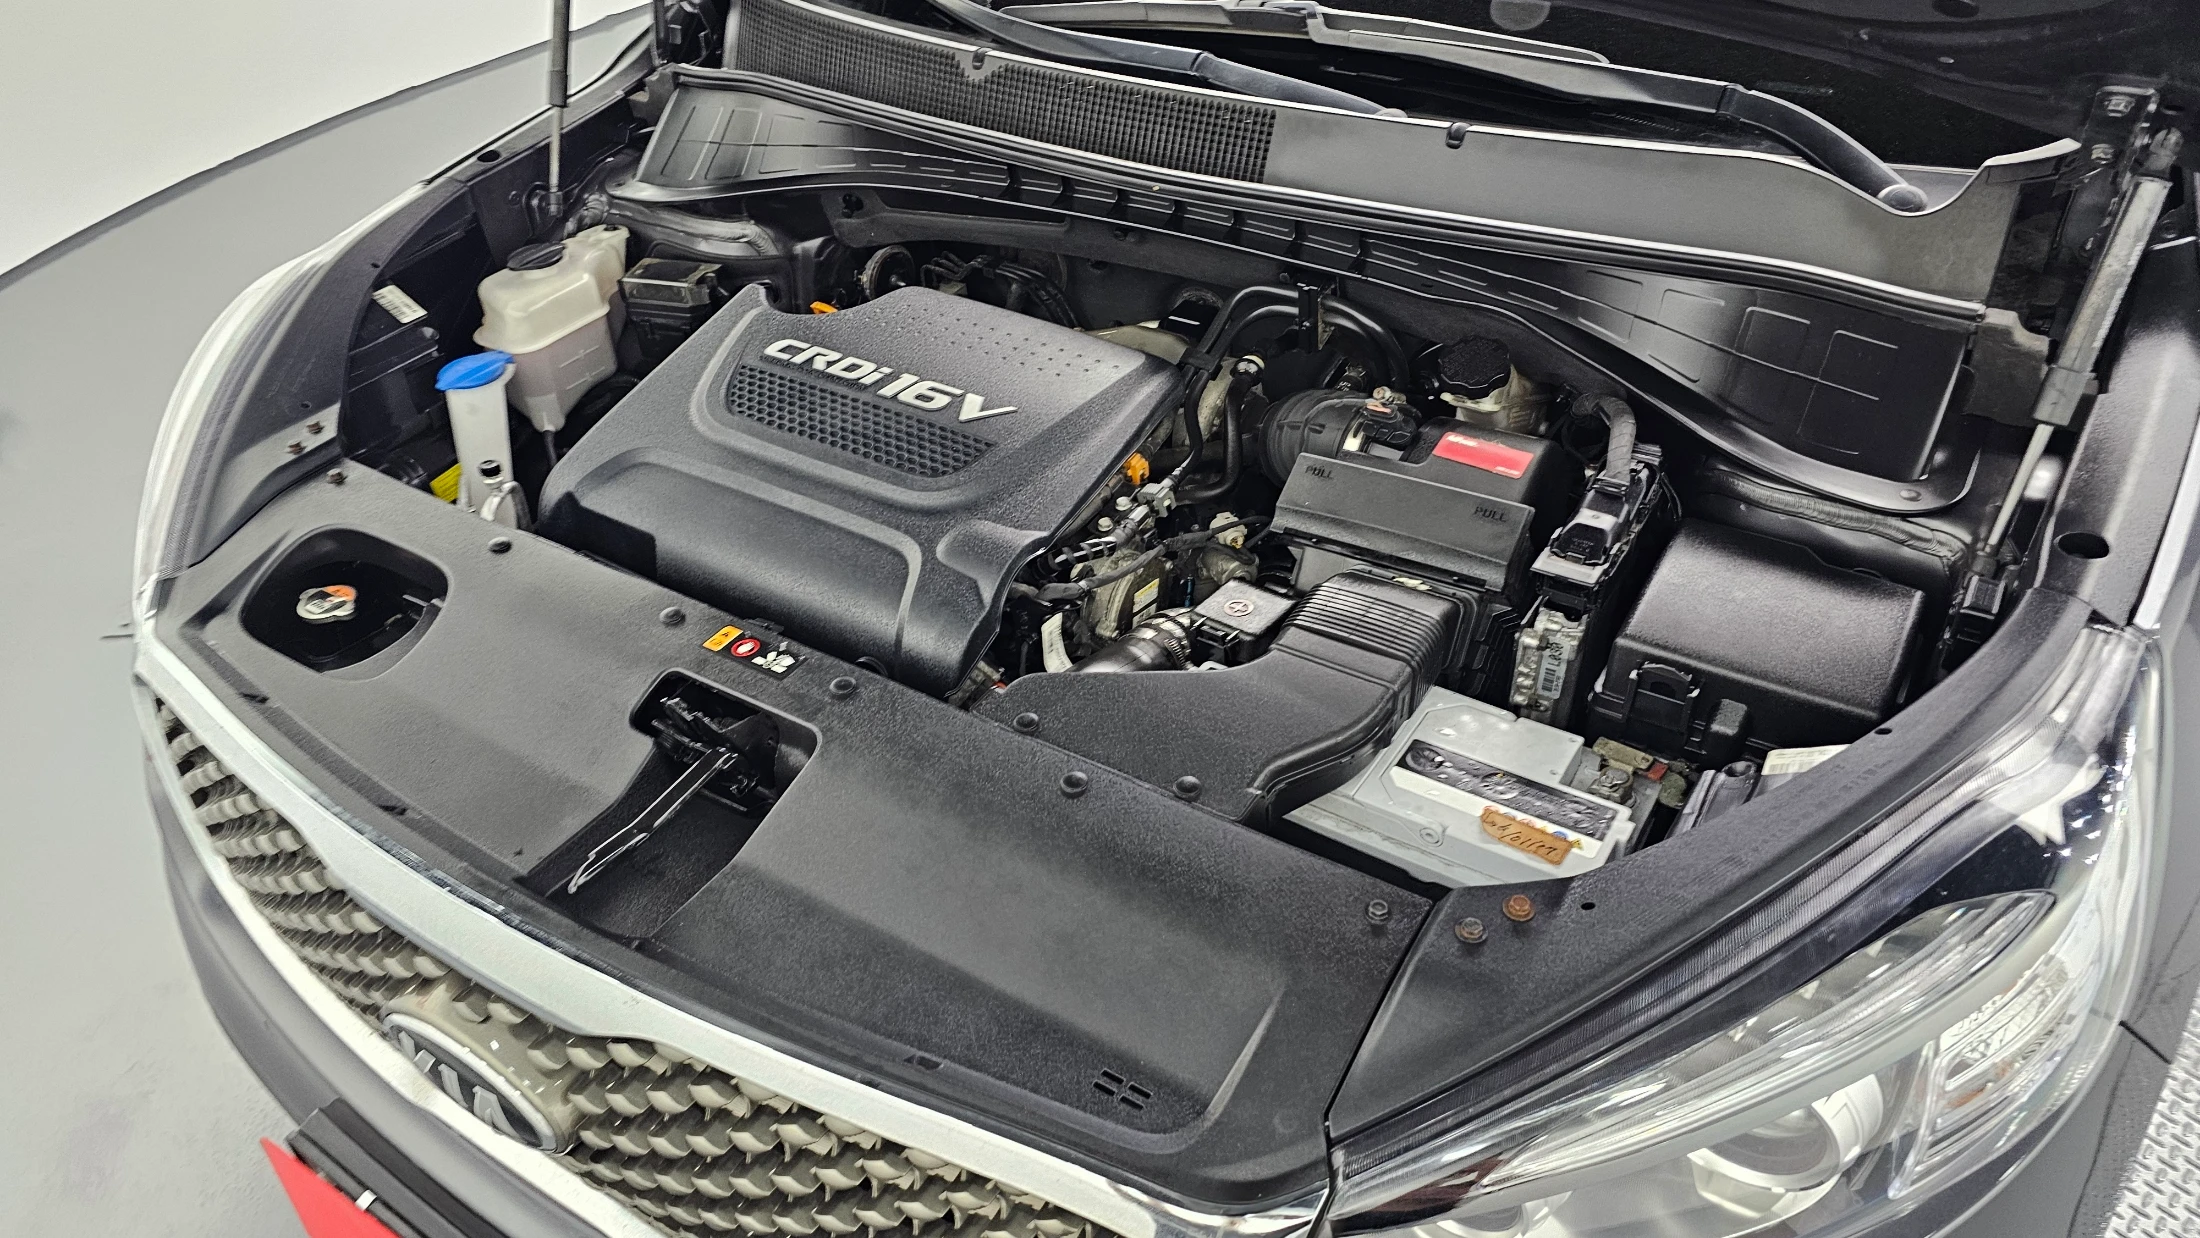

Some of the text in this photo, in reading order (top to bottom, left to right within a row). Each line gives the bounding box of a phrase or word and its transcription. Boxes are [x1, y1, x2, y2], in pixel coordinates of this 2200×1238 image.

[763, 339, 1018, 423] CRDi 16V
[1304, 464, 1335, 480] PULL
[1473, 504, 1508, 523] PULL
